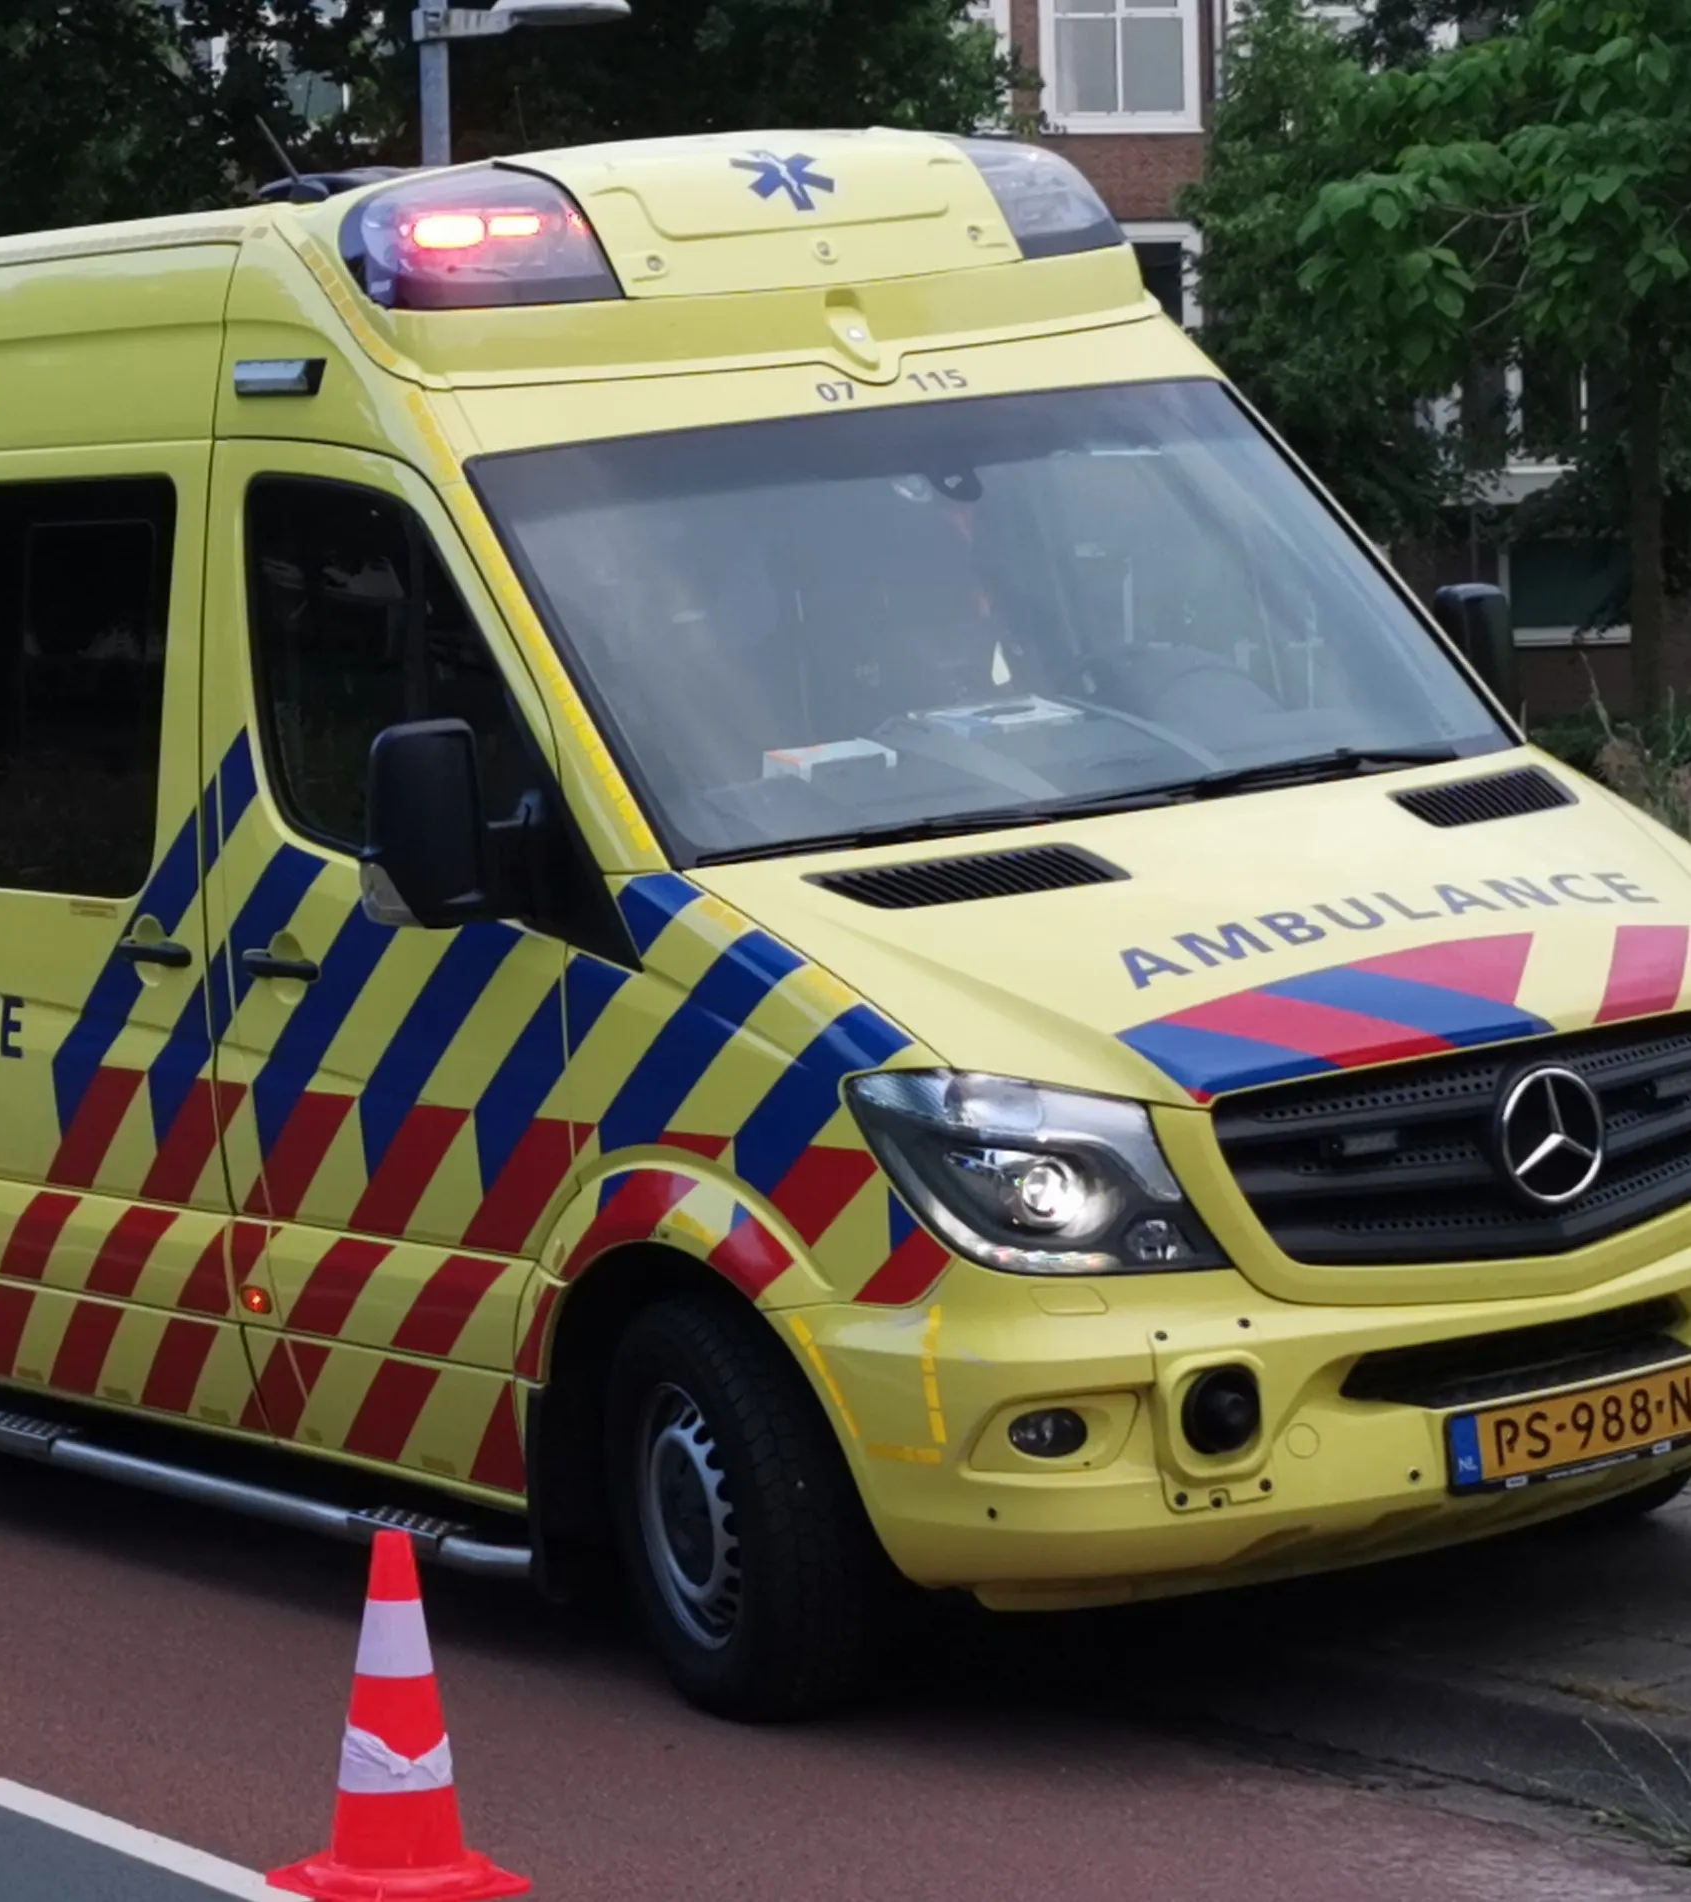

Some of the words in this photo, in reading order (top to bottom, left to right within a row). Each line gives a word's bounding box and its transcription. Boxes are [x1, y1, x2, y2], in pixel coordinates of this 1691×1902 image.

[815, 380, 855, 402] 07
[906, 368, 969, 392] 115
[1118, 871, 1661, 990] AMBULANCE
[1457, 1455, 1480, 1474] NL
